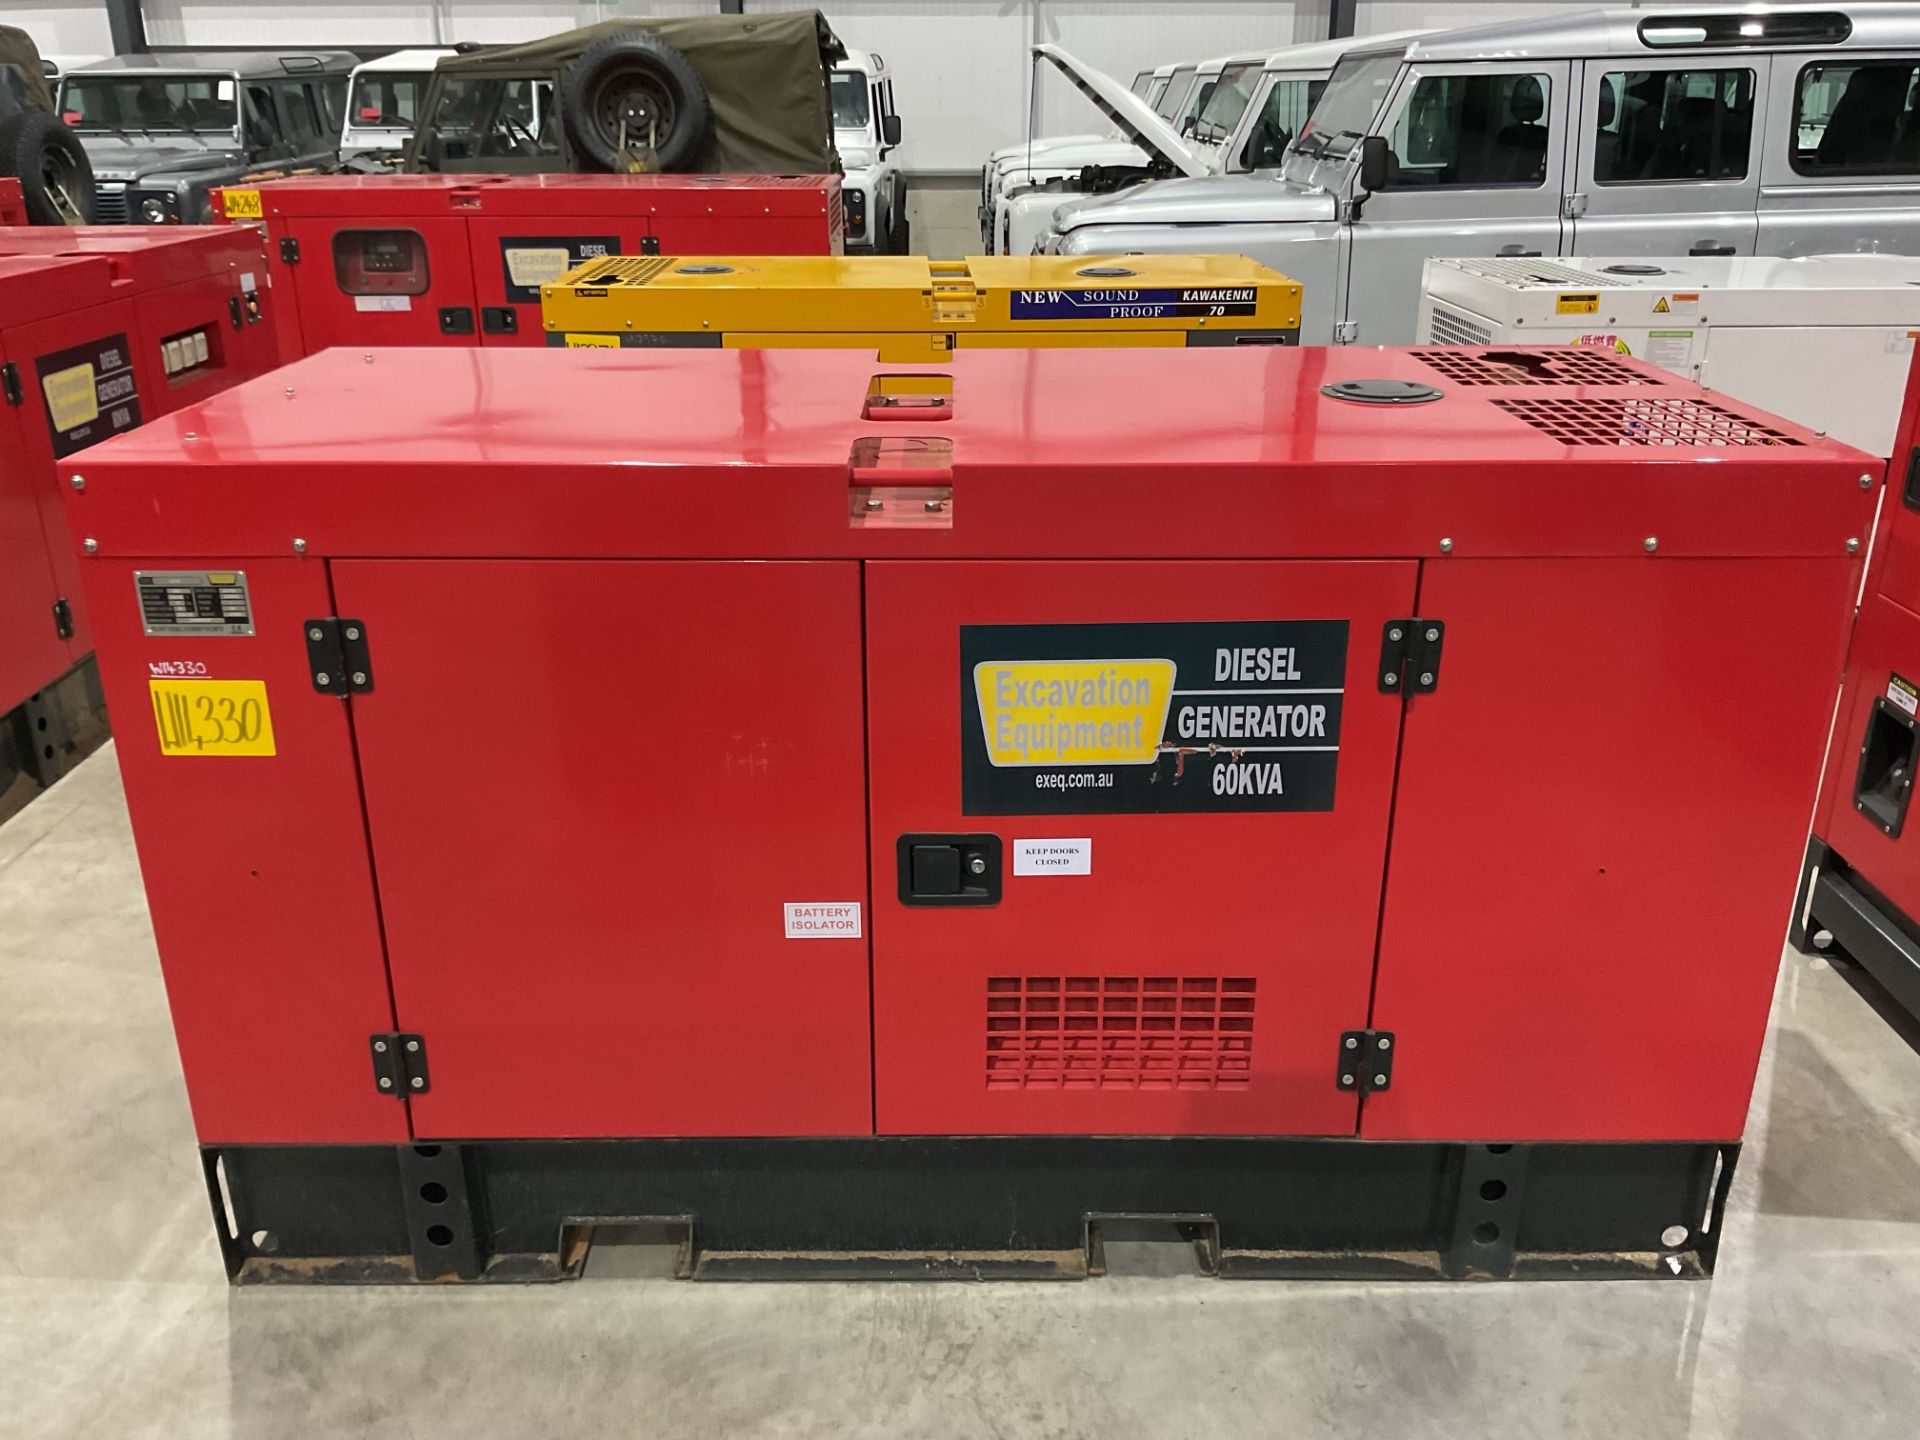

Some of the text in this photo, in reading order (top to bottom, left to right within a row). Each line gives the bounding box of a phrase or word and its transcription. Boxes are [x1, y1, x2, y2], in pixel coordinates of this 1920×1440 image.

[580, 244, 608, 257] DIESEL
[1020, 290, 1139, 304] NEW SOUND
[1183, 289, 1254, 302] KAWAKENKI
[1110, 306, 1164, 318] PROOF
[1209, 306, 1225, 317] 70
[1214, 647, 1301, 682] DIESEL
[995, 668, 1151, 709] Excavation
[1178, 704, 1326, 739] GENERATOR
[995, 713, 1144, 759] Equipment
[1035, 771, 1114, 793] exeq.com.au
[1212, 762, 1284, 796] 60KVA
[1050, 847, 1080, 855] DOORS
[1035, 858, 1070, 866] CLOSED
[794, 908, 851, 917] BATTERY
[791, 921, 854, 930] ISOLATOR
